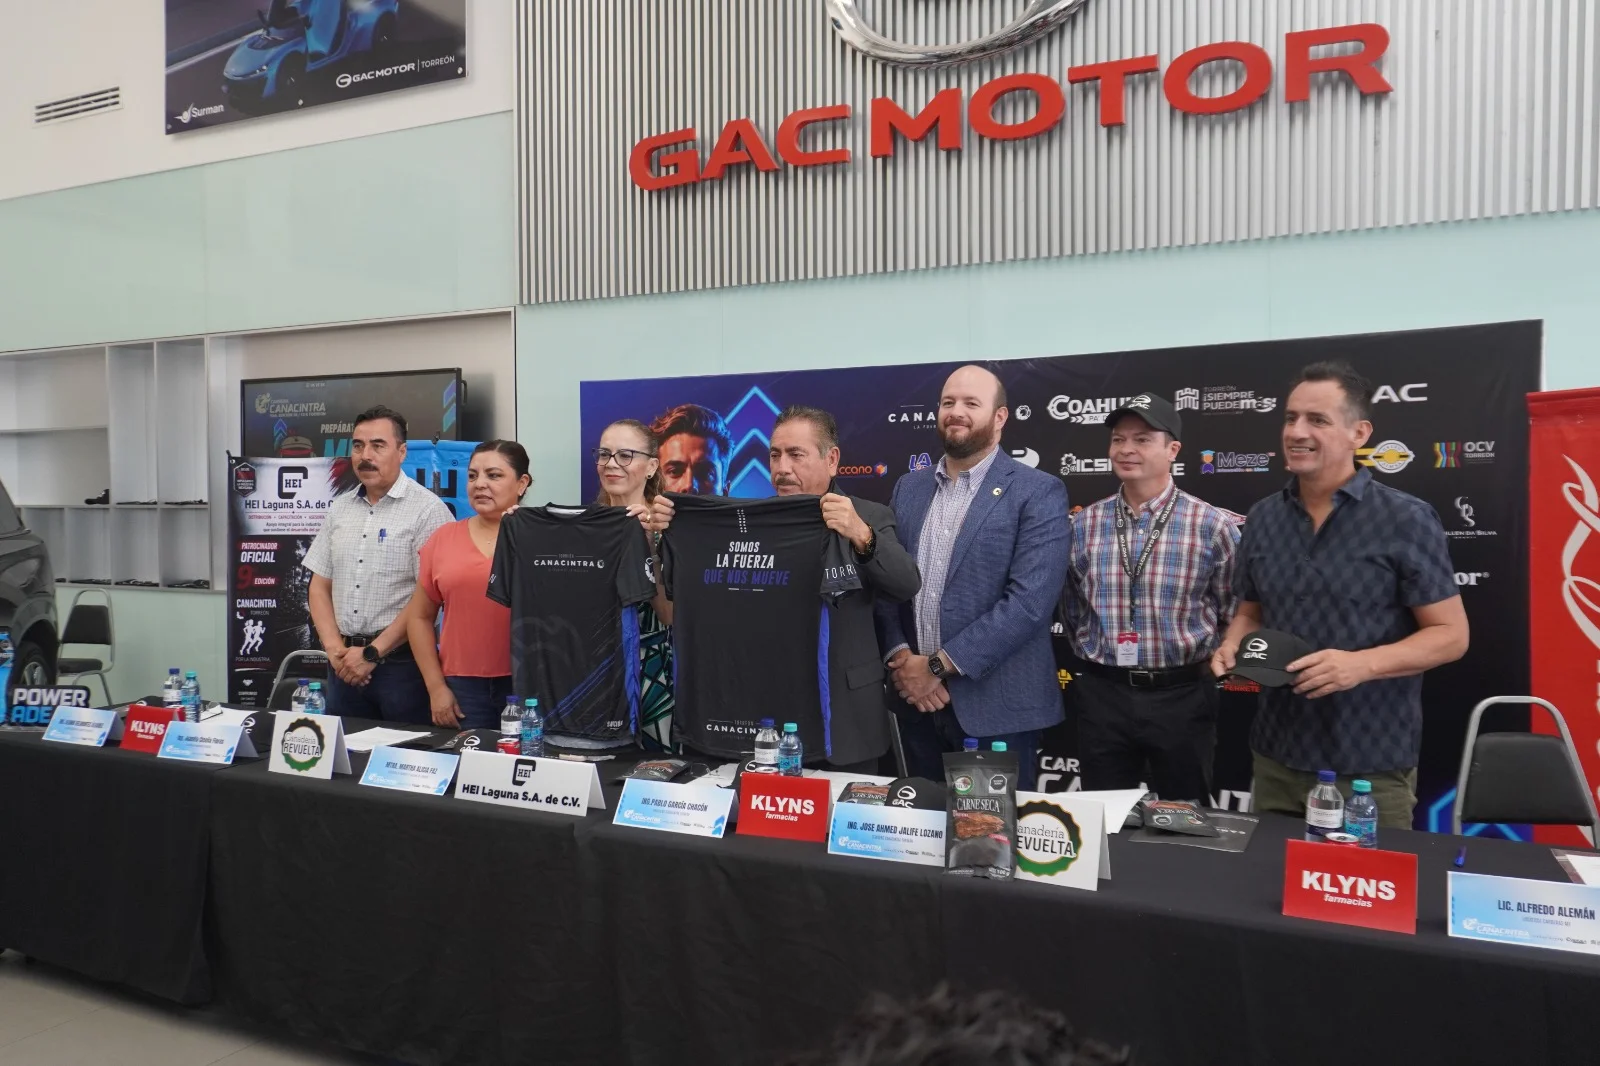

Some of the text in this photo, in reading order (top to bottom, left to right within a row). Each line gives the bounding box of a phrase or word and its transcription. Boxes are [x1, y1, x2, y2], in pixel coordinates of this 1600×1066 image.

[376, 62, 416, 78] MOTOR
[421, 56, 455, 69] TORREÓN
[191, 104, 225, 118] Surman
[629, 23, 1393, 191] GAC MOTOR
[269, 402, 326, 414] CANACINTRA
[1047, 394, 1132, 420] COAHU
[888, 411, 936, 423] CANA
[1464, 441, 1495, 452] OCV
[1217, 451, 1270, 468] Meze
[836, 465, 873, 475] ccano
[284, 479, 302, 489] HEI
[245, 500, 259, 509] HEI
[262, 500, 294, 511] Laguna
[296, 500, 313, 509] S.A.
[315, 499, 326, 509] de
[241, 542, 278, 550] PATROCINADOR
[728, 541, 760, 553] SOMOS
[240, 551, 276, 563] OFICIAL
[715, 553, 775, 569] LA FUERZA
[236, 565, 253, 590] 9
[254, 577, 276, 585] EDICIÓN
[704, 569, 791, 586] QUE NOS MUEVE
[236, 599, 277, 609] CANACINTRA
[1242, 652, 1268, 660] GAC
[13, 688, 87, 706] POWER
[11, 706, 53, 724] ADE
[130, 720, 165, 736] KLYNS
[283, 742, 320, 756] REVUELTA
[1040, 756, 1081, 773] CAR
[517, 768, 532, 778] HEI
[462, 783, 581, 808] HEI Laguna S.A. de C.V.
[751, 794, 815, 815] KLYNS
[956, 797, 1000, 813] CARNE SECA
[765, 811, 799, 822] farmacias
[847, 821, 858, 830] ING.
[860, 822, 875, 832] JOSE
[876, 824, 898, 834] AHMED
[899, 826, 918, 837] JALIFE
[920, 828, 943, 839] LOZANO
[1017, 835, 1073, 856] EVUELTA
[1302, 869, 1396, 901] KLYNS
[1323, 893, 1373, 908] farmacias
[1498, 899, 1514, 912] LIC.
[1516, 902, 1555, 916] ALFREDO
[1557, 906, 1596, 920] ALEMÁN
[1476, 925, 1530, 938] CANACINTRA
